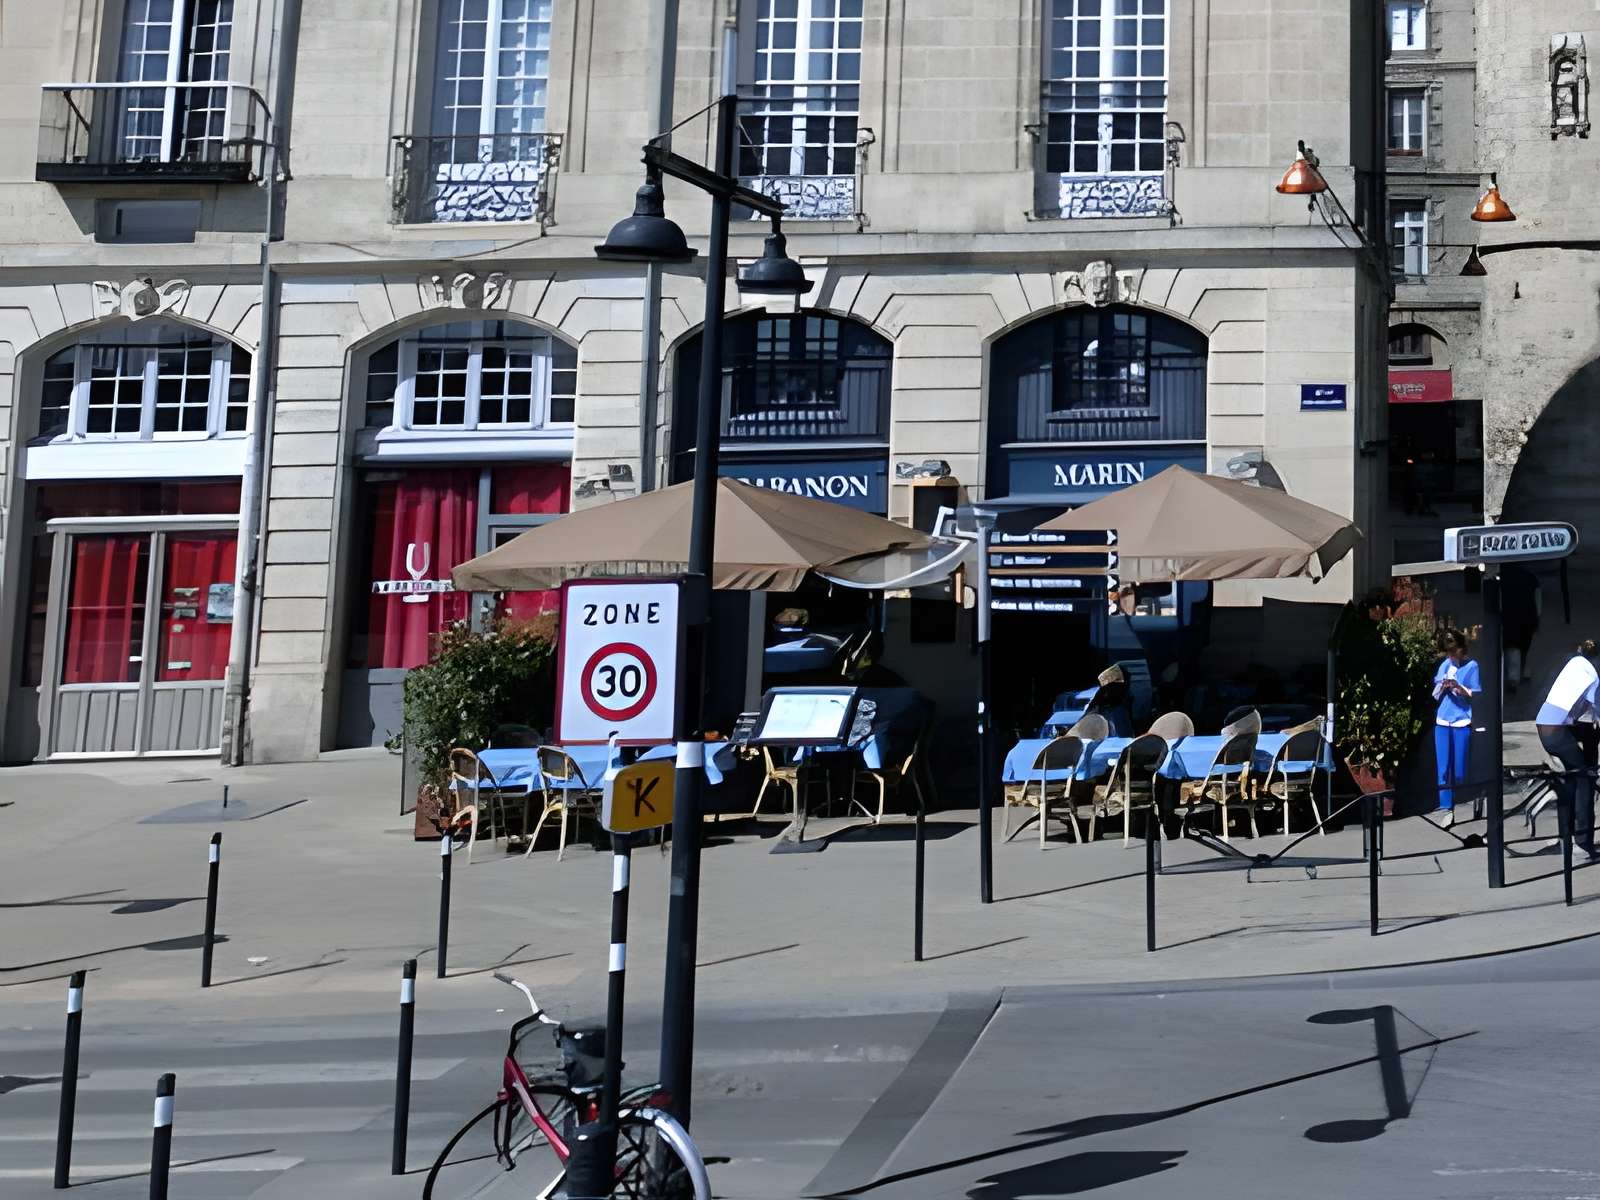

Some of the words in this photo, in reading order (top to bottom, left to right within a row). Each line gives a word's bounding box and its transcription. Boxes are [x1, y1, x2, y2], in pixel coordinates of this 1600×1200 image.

[1054, 461, 1144, 486] MARIN
[583, 603, 660, 626] ZONE
[596, 664, 642, 698] 30
